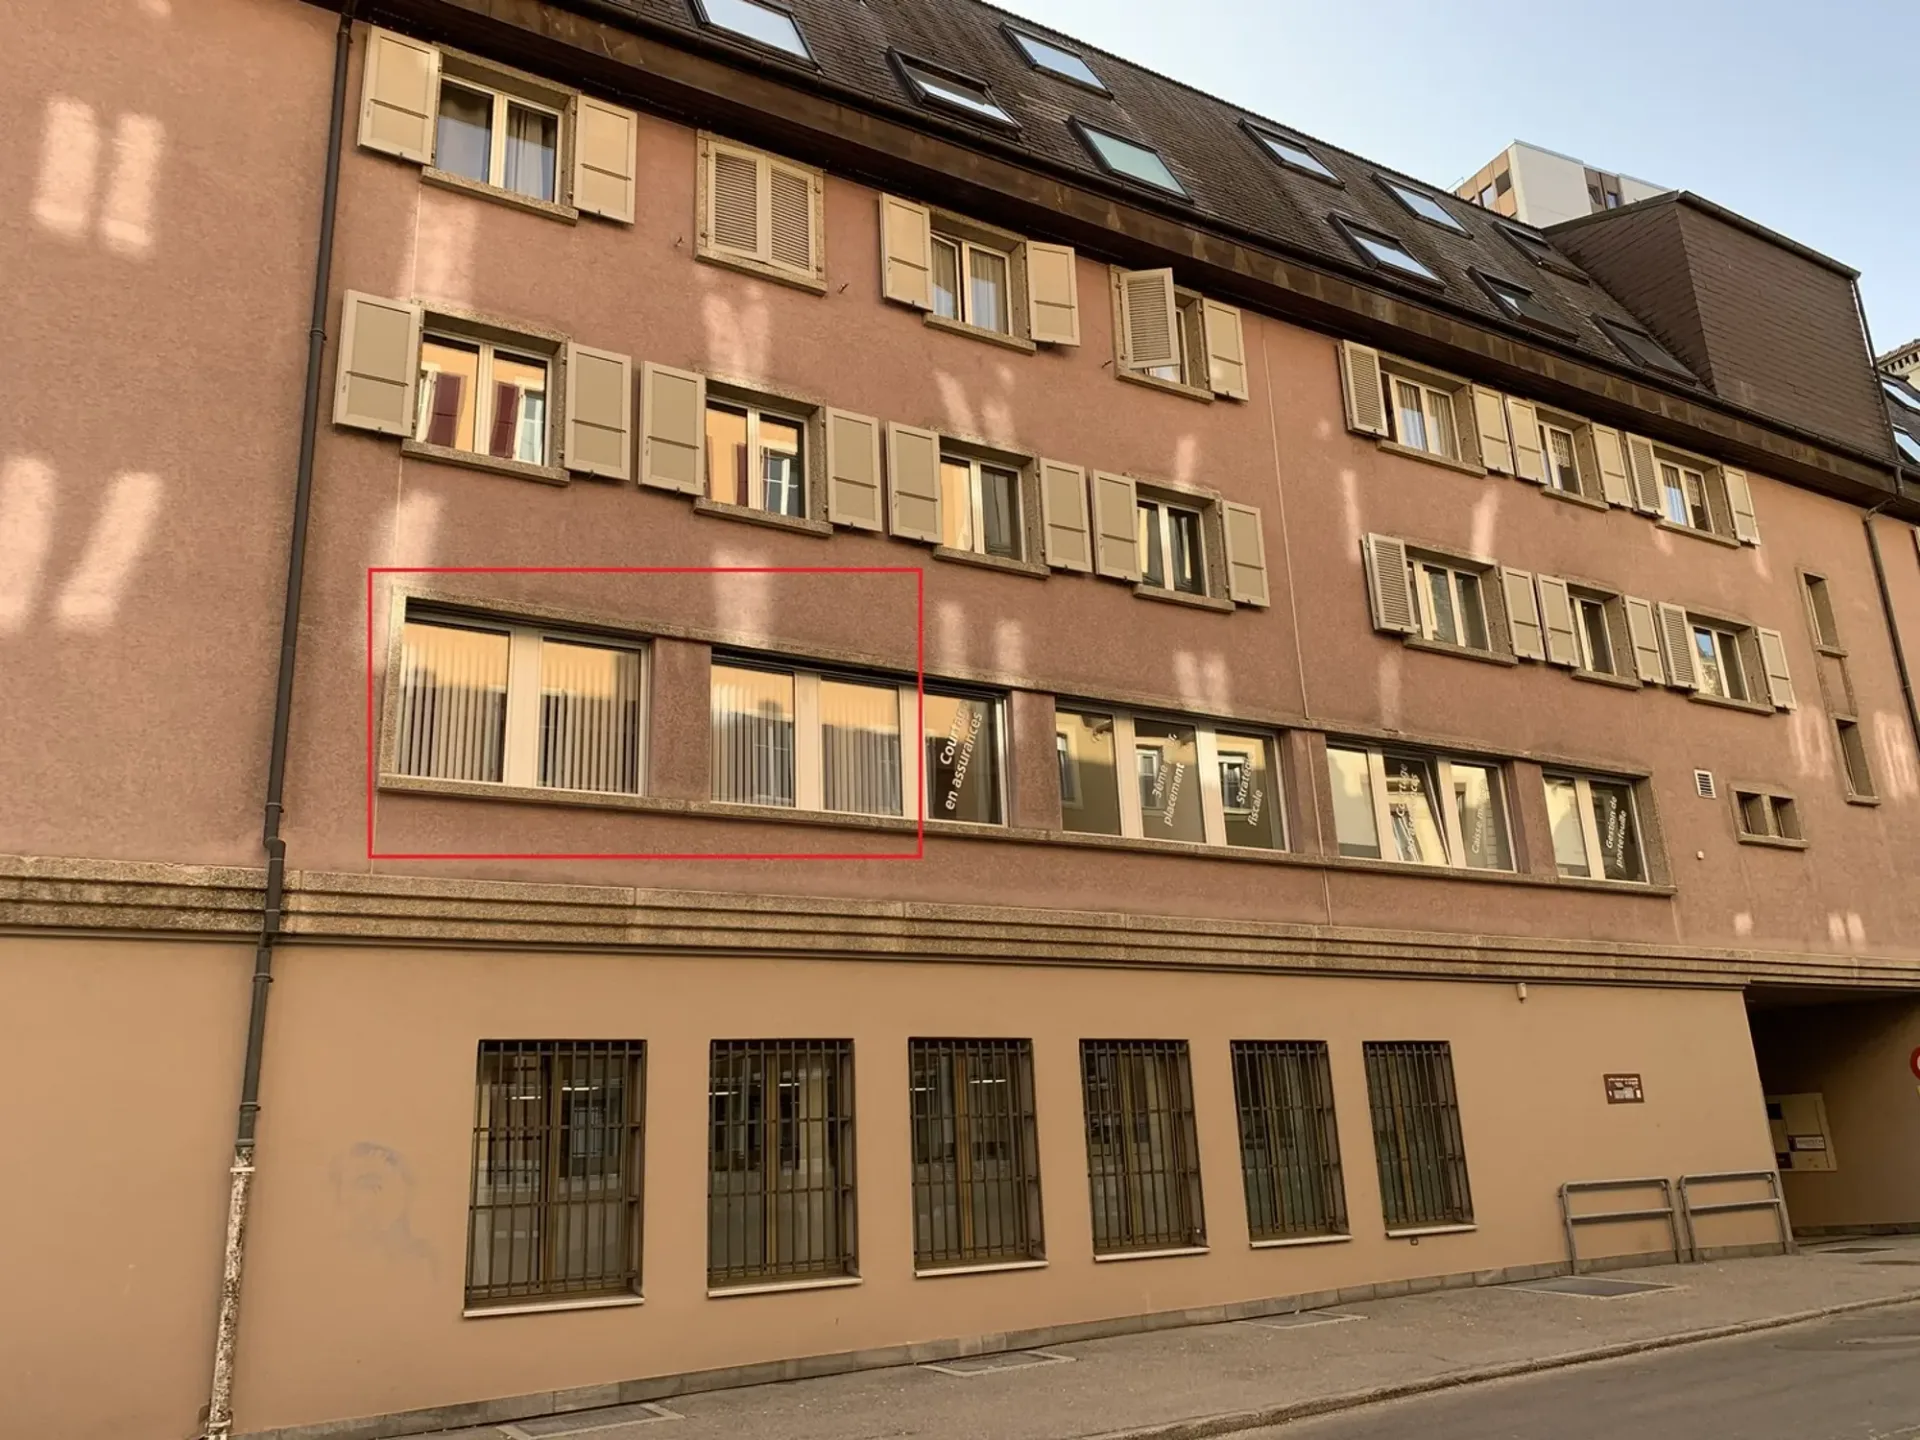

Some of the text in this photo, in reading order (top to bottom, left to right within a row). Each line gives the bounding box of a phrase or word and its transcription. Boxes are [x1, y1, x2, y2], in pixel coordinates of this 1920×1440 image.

[940, 698, 970, 765] Courtag
[945, 712, 982, 810] en assurances
[1236, 752, 1256, 805] Stratég
[1163, 762, 1185, 827] placement
[1247, 789, 1263, 827] fiscale
[1395, 763, 1409, 817] Cortge
[1605, 796, 1618, 849] Gestion de
[1616, 809, 1627, 869] portefeuille
